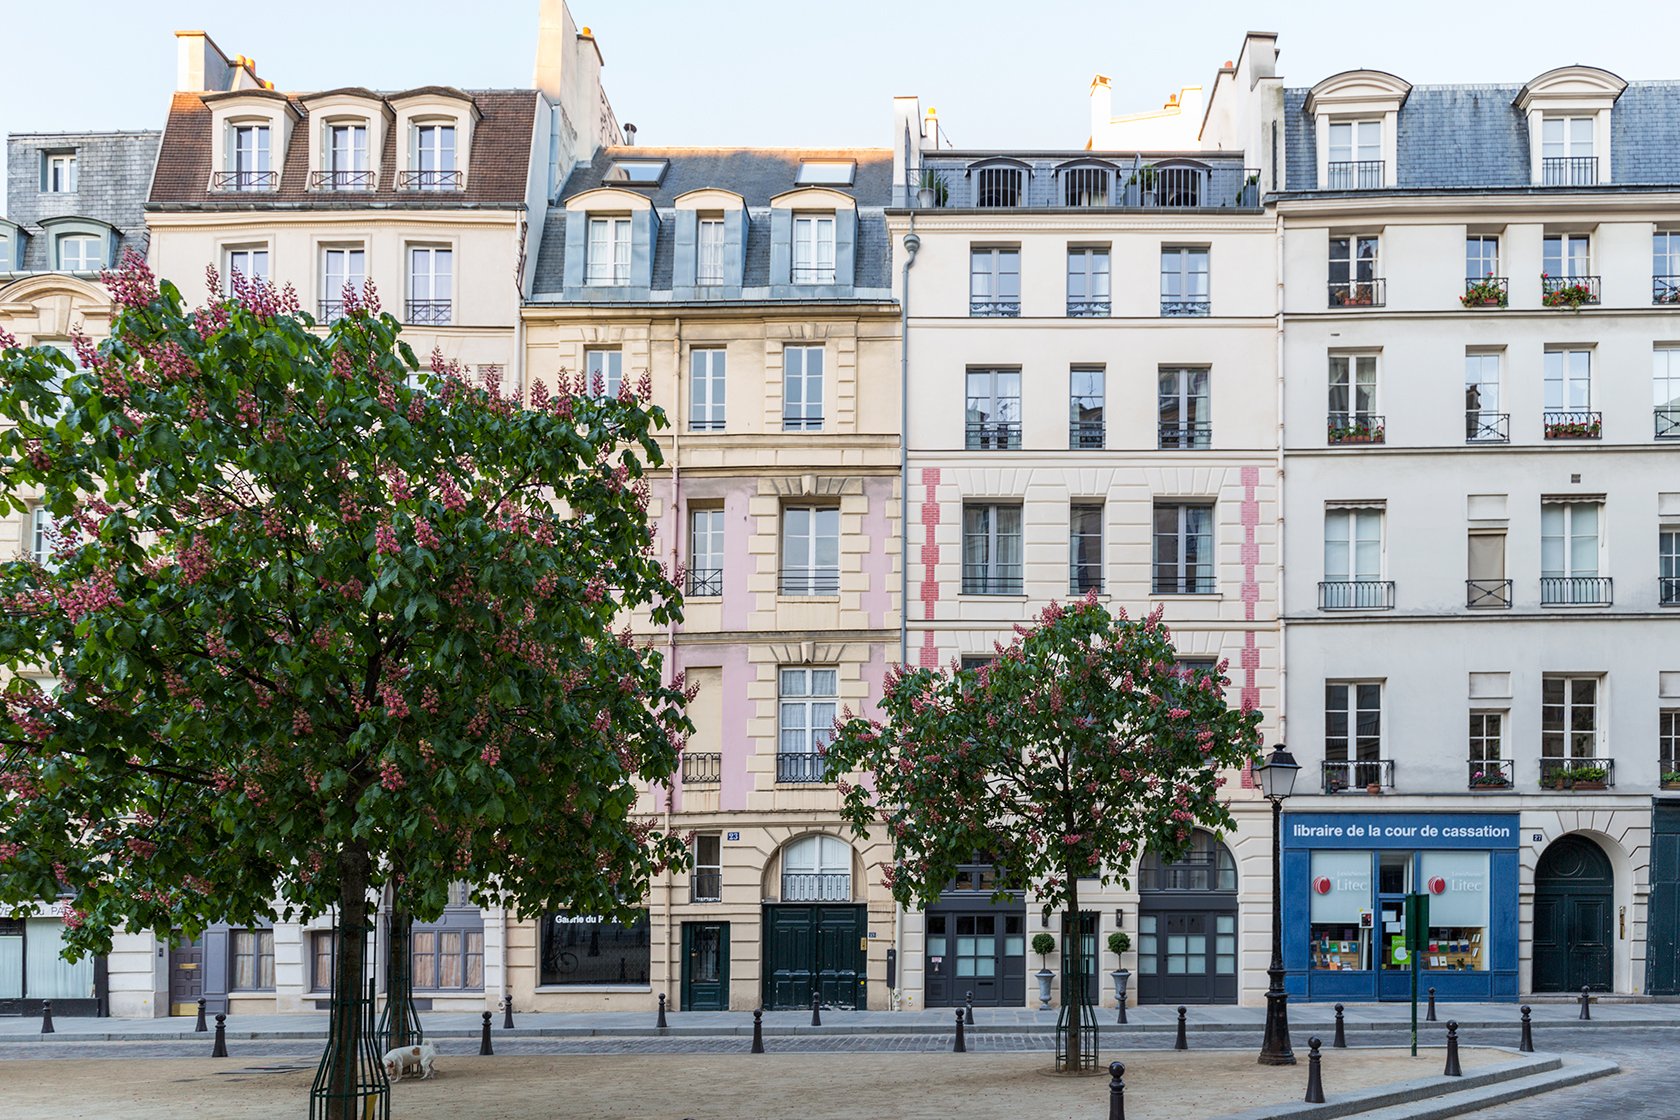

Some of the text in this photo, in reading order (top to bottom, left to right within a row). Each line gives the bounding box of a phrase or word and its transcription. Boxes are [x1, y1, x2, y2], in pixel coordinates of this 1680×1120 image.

[728, 832, 739, 840] 23
[1293, 825, 1510, 838] libraire de la cour de cassation
[1336, 878, 1367, 888] Litec
[1451, 878, 1481, 888] Litec
[585, 915, 596, 924] du
